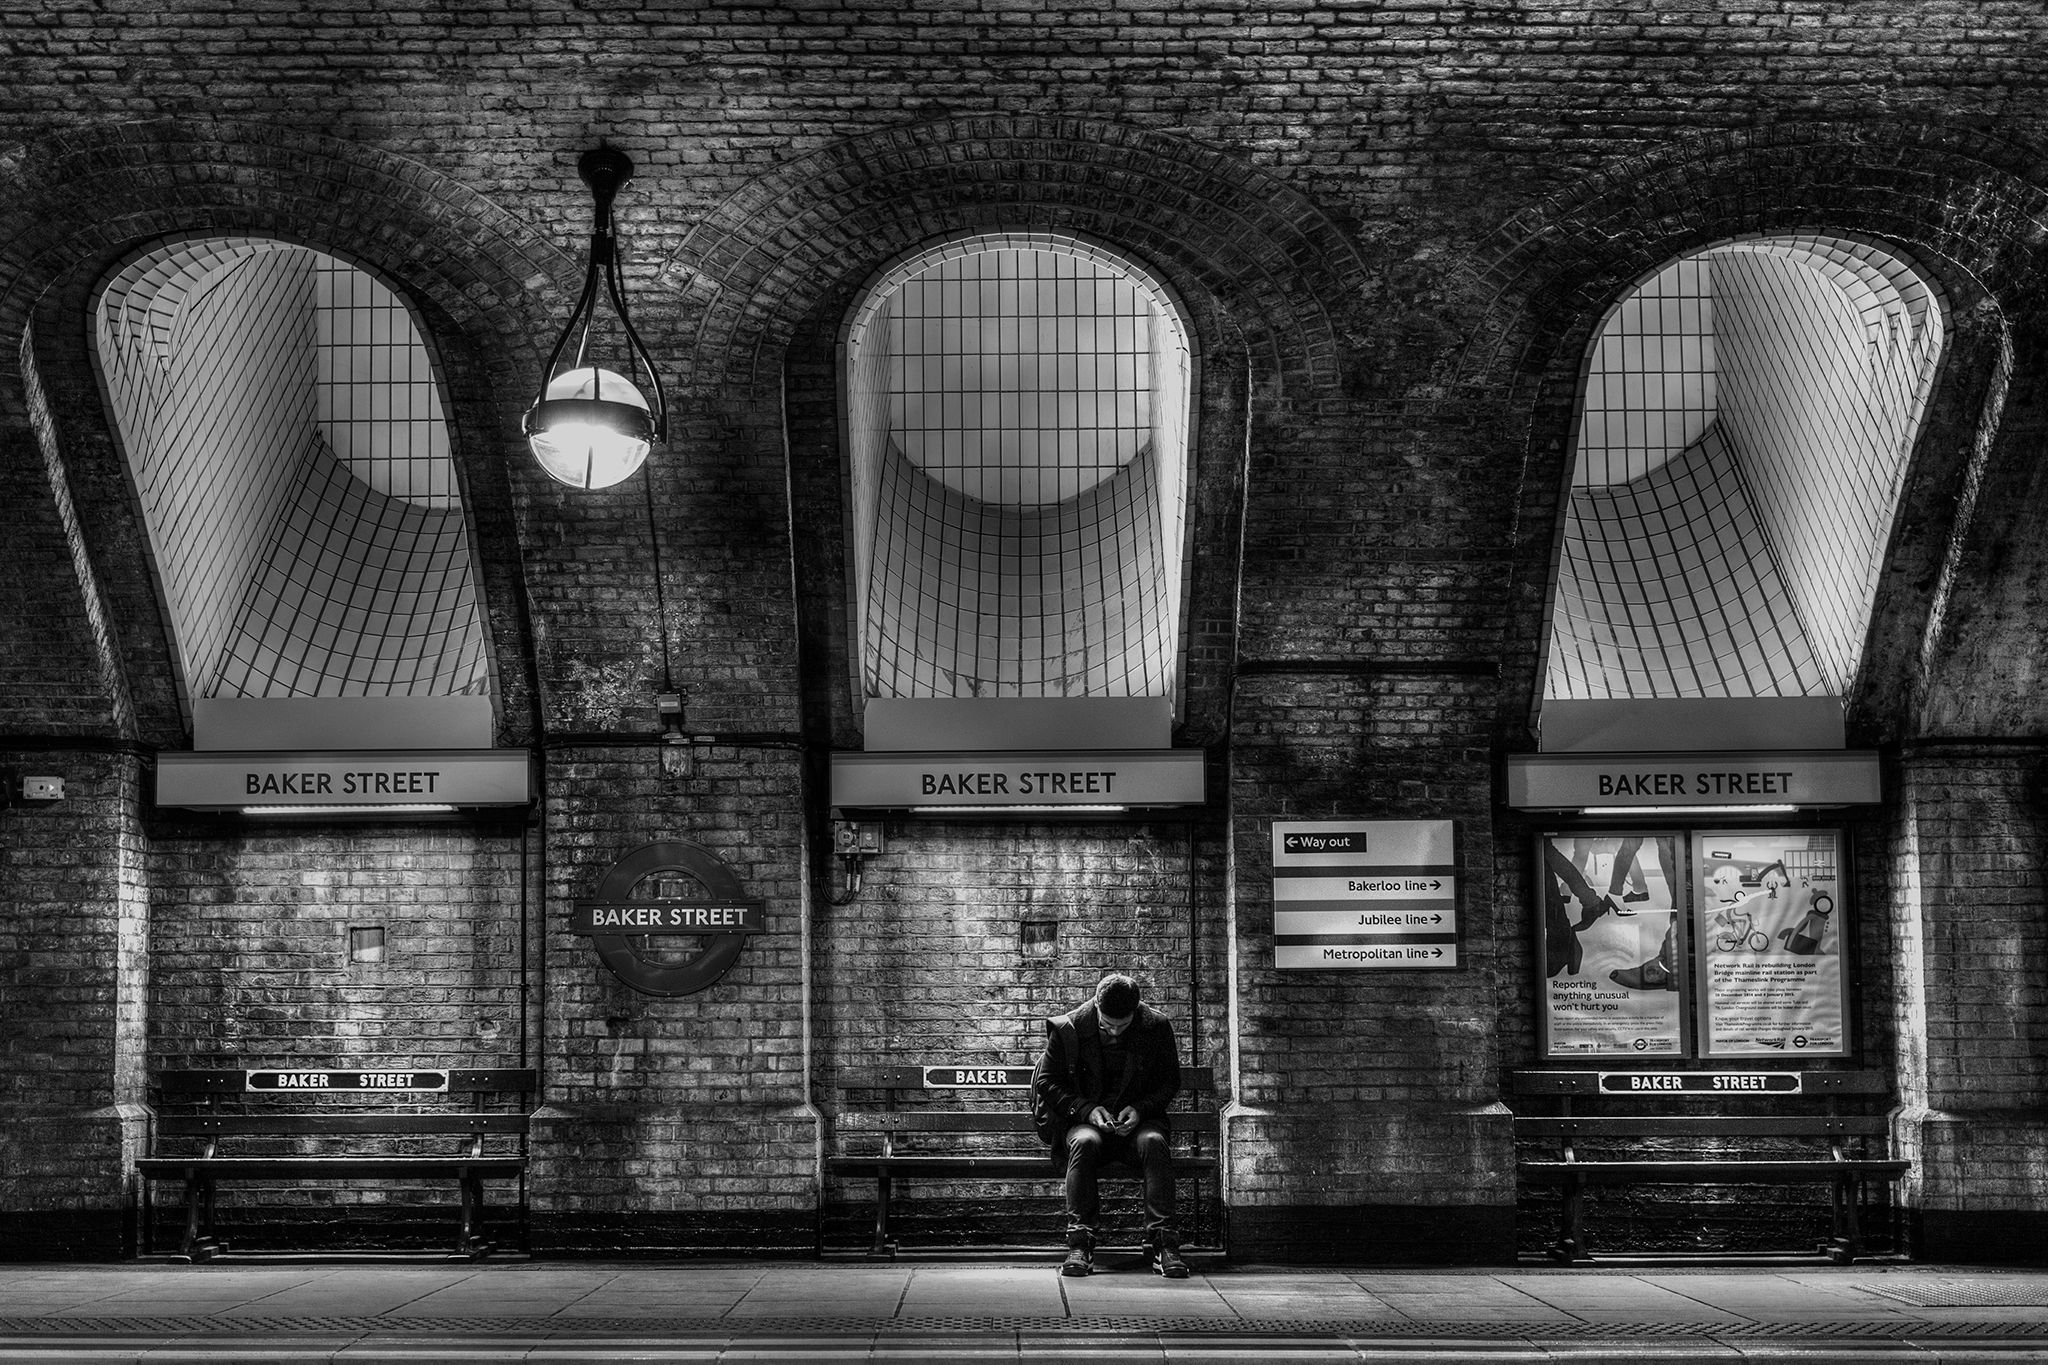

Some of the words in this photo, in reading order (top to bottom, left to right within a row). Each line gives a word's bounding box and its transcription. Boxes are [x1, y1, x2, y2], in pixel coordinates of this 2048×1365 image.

[246, 773, 332, 795] BAKER
[342, 772, 439, 795] STREET
[922, 773, 1009, 795] BAKER
[1019, 771, 1116, 794] STREET
[1598, 774, 1686, 796] BAKER
[1695, 773, 1792, 795] STREET
[1300, 837, 1326, 850] Way
[1329, 837, 1351, 847] out
[1348, 880, 1401, 892] Bakerloo
[1405, 880, 1427, 891] line
[592, 908, 663, 926] BAKER
[669, 908, 748, 926] STREET
[1358, 914, 1402, 925] Jubilee
[1406, 914, 1428, 925] line
[1323, 948, 1403, 962] Metropolitan
[1407, 948, 1429, 959] line
[1552, 980, 1597, 990] Reporting
[1553, 991, 1592, 1001] anything
[1594, 991, 1629, 1000] unusual
[1553, 1002, 1579, 1011] won't
[1581, 1002, 1600, 1010] hurt
[1602, 1003, 1618, 1012] you
[277, 1073, 329, 1088] BAKER
[359, 1073, 414, 1088] STREET
[956, 1070, 1008, 1084] BAKER
[1630, 1076, 1683, 1090] BAKER
[1713, 1075, 1768, 1090] STREET
